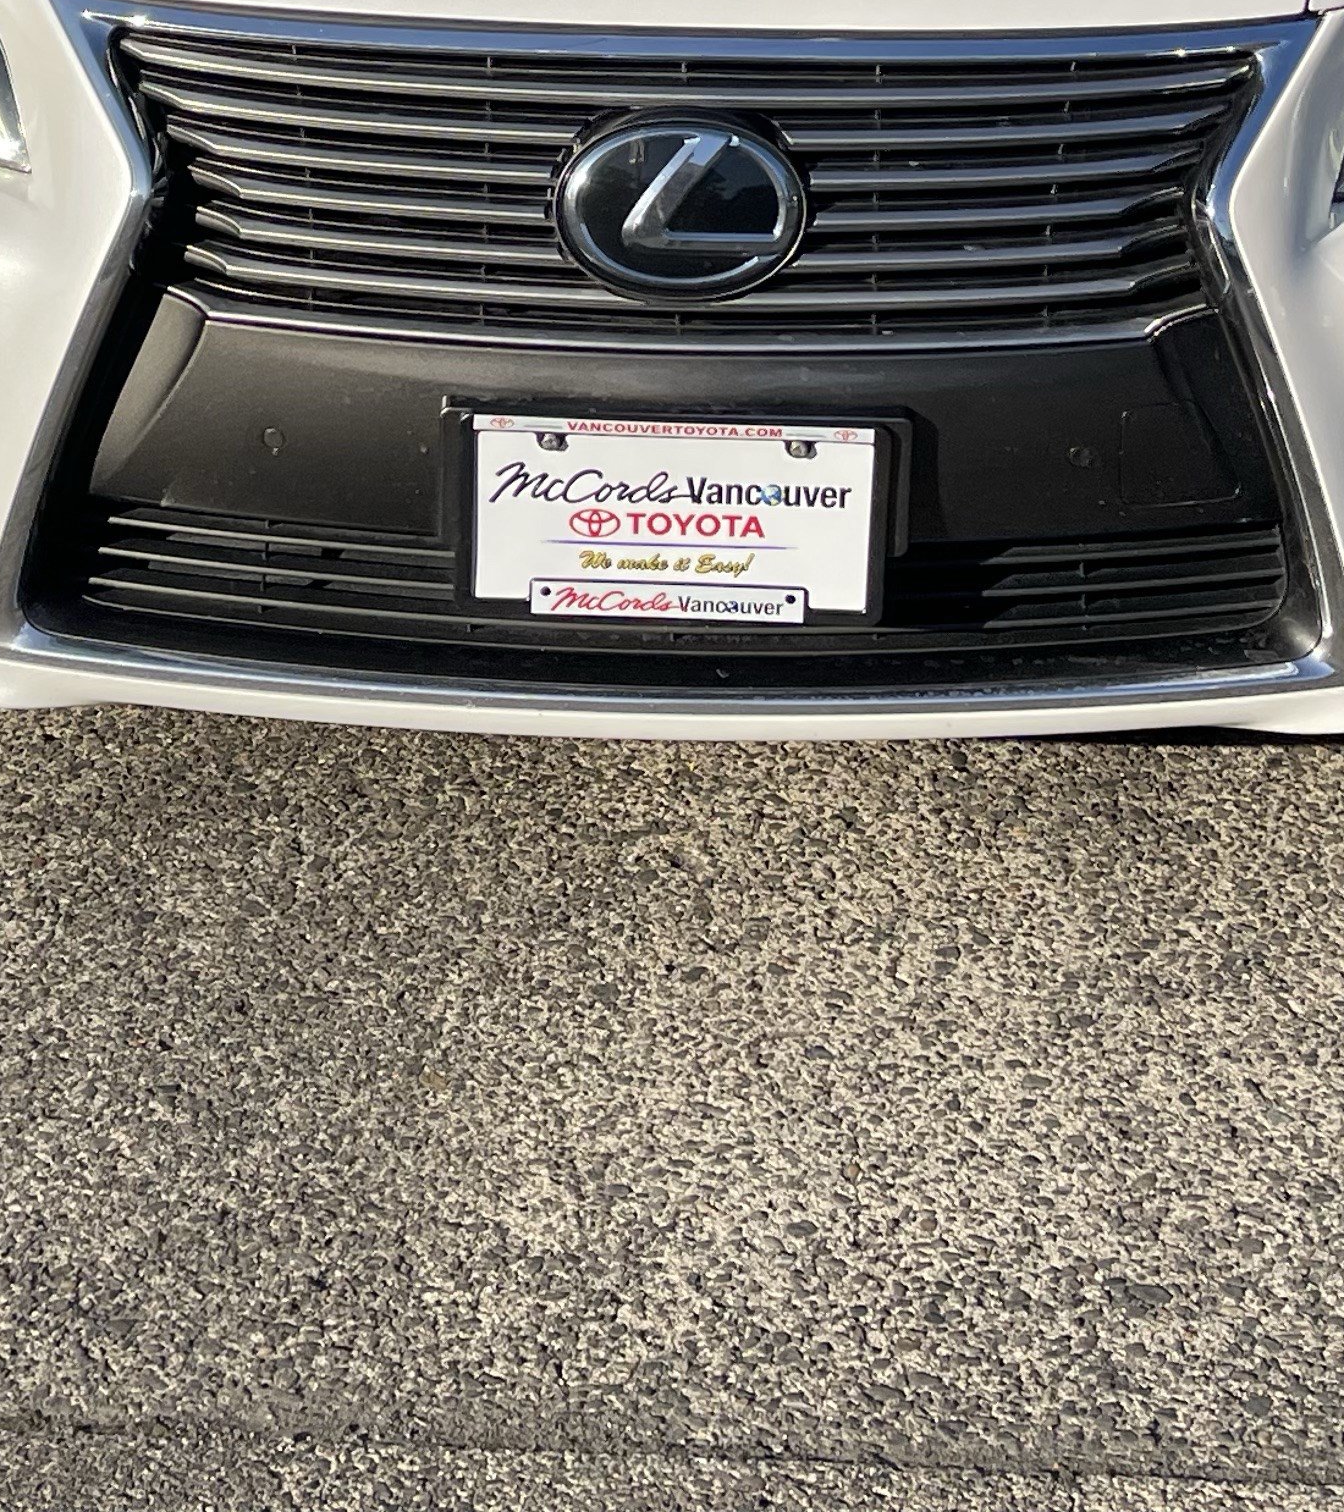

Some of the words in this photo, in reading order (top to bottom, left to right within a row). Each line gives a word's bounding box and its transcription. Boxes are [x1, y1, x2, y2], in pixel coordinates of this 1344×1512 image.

[567, 421, 783, 438] VANCOUVERTOYOTA.COM
[627, 512, 766, 538] TOYOTA
[579, 550, 612, 569] We
[617, 553, 668, 571] make
[673, 555, 691, 571] it
[695, 553, 755, 578] Easy!
